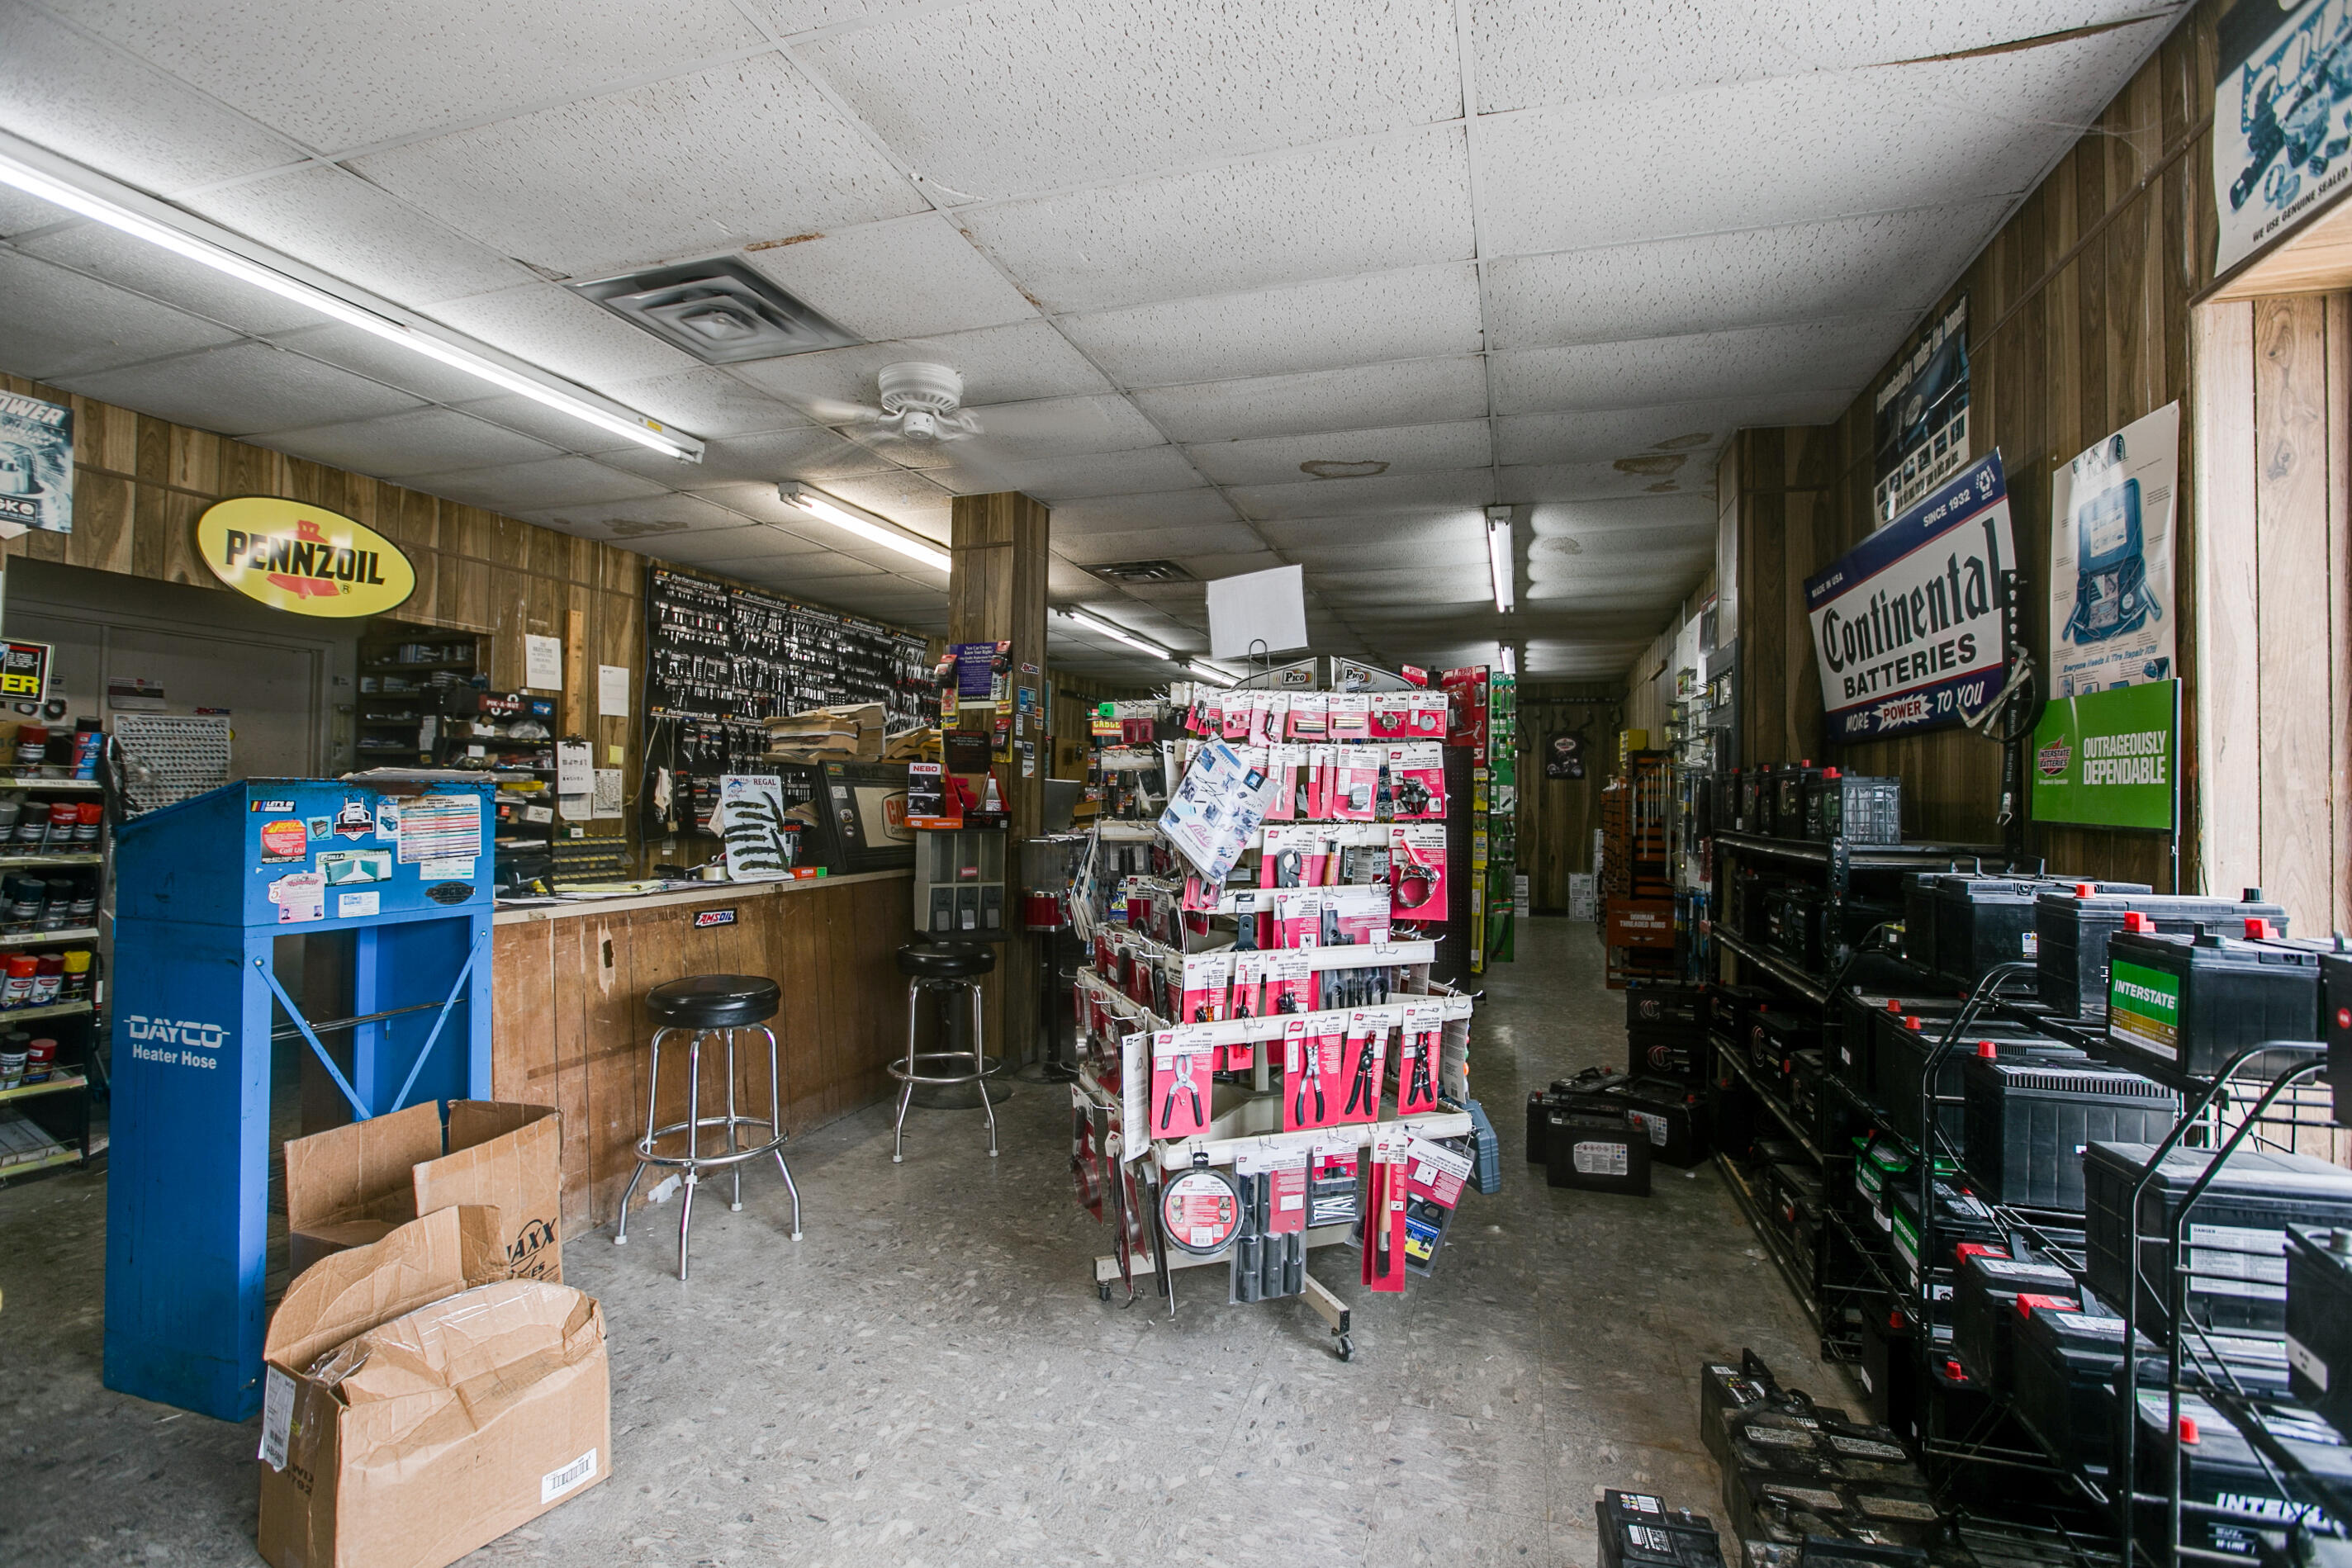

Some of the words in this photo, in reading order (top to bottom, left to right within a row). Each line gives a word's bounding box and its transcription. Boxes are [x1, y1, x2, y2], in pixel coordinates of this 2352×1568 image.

[2253, 227, 2264, 242] WE
[2266, 216, 2279, 233] USE
[2282, 190, 2315, 221] GENUINE
[2318, 167, 2348, 195] SEALED
[1923, 504, 1947, 527] SINCE
[1949, 489, 1971, 510] 1932
[225, 528, 386, 585] PENNZOIL
[671, 574, 706, 589] Performance
[707, 581, 722, 591] Tool
[1811, 581, 1827, 598] MADE
[1832, 572, 1843, 586] USA
[1823, 517, 2002, 673] Continental
[744, 592, 774, 605] Performance
[775, 599, 787, 608] Tool
[800, 607, 826, 618] Performance
[1844, 632, 1976, 699] BATTERIES
[2063, 662, 2086, 673] Everyone
[2123, 648, 2144, 660] Repair
[0, 672, 40, 694] ER
[486, 700, 519, 708] PIK-A-NUT
[666, 708, 701, 718] Performance
[1846, 712, 1870, 732] MORE
[1883, 701, 1922, 722] POWER
[1937, 691, 1951, 713] TO
[1956, 681, 1984, 705] YOU
[2039, 749, 2070, 758] INTERSTATE
[2084, 730, 2167, 759] OUTRAGEOUSLY
[2039, 759, 2068, 768] BATTERIES
[2084, 756, 2165, 785] DEPENDABLE
[753, 778, 776, 786] REGAL
[699, 911, 735, 925] AMSOIL
[2115, 979, 2176, 1010] INTERSTATE
[128, 1015, 225, 1049] DAYCO
[133, 1044, 178, 1063] Heater
[182, 1050, 217, 1069] Hose
